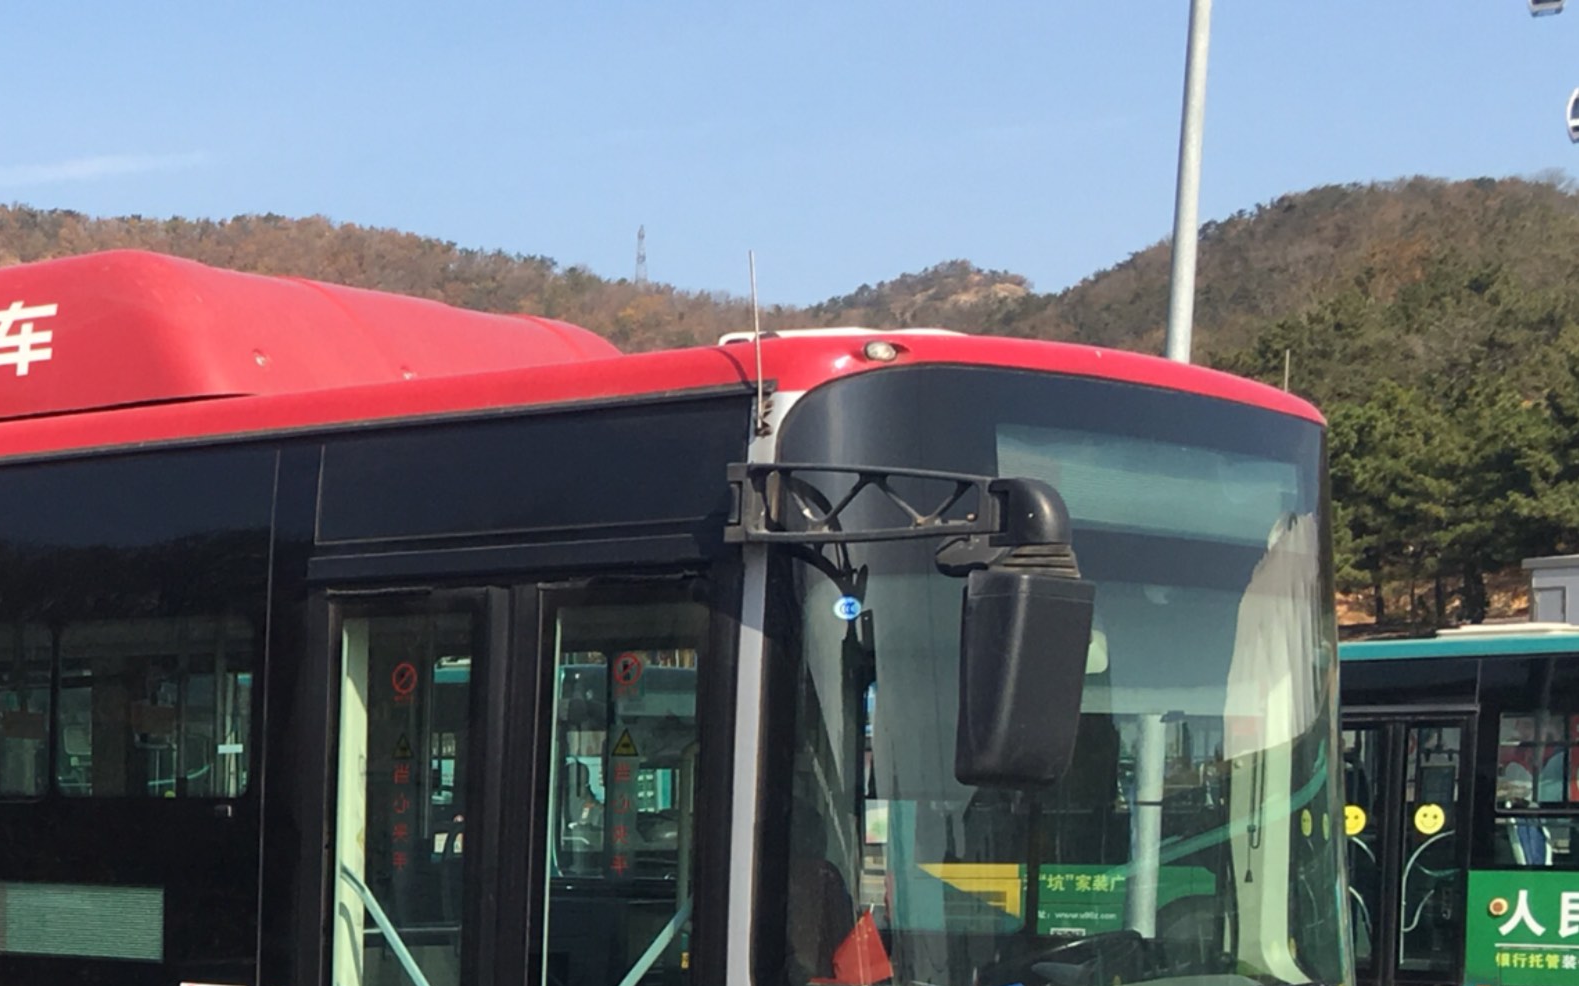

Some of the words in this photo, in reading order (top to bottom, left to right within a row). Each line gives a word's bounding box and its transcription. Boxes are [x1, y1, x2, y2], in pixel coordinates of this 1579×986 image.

[1495, 951, 1579, 970] 银行托管装
